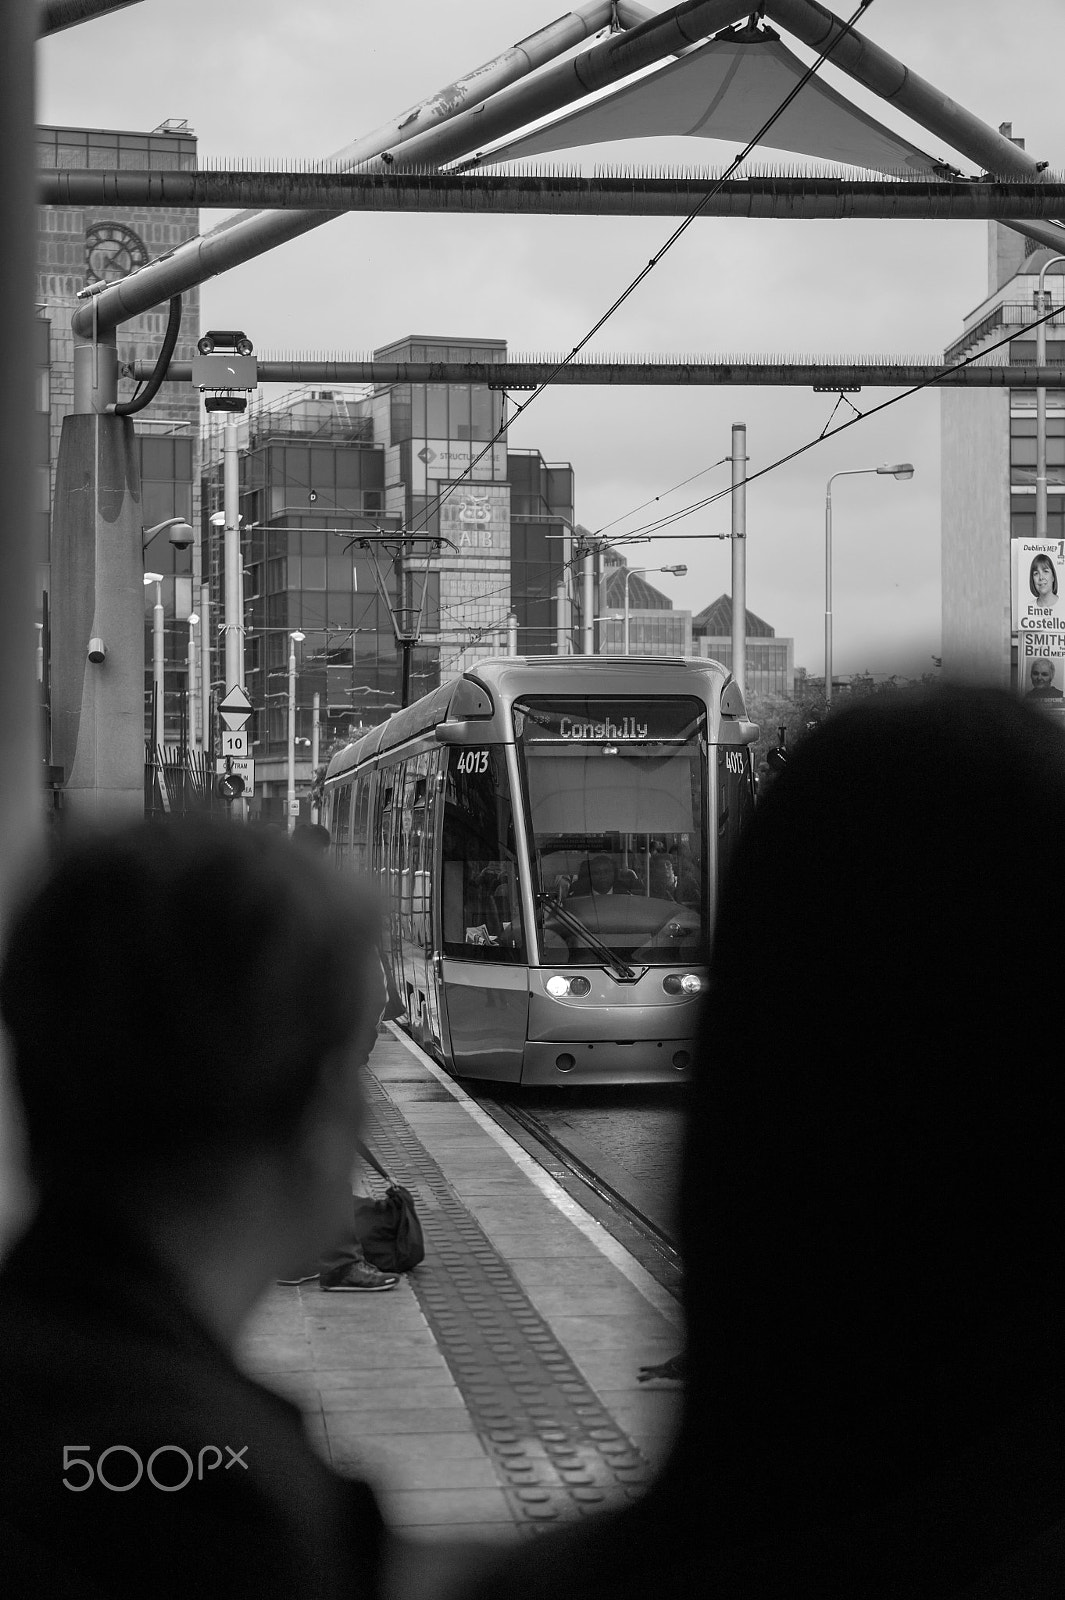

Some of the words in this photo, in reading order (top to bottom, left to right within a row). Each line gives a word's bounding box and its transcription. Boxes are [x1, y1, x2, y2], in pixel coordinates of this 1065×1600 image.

[460, 531, 493, 548] AIB
[1023, 544, 1046, 552] Dublin's
[1027, 605, 1053, 616] Emer
[1020, 617, 1065, 629] Costello
[1025, 633, 1065, 646] SMITH
[227, 738, 242, 749] 10
[457, 751, 489, 774] 4013
[725, 751, 744, 775] 4013
